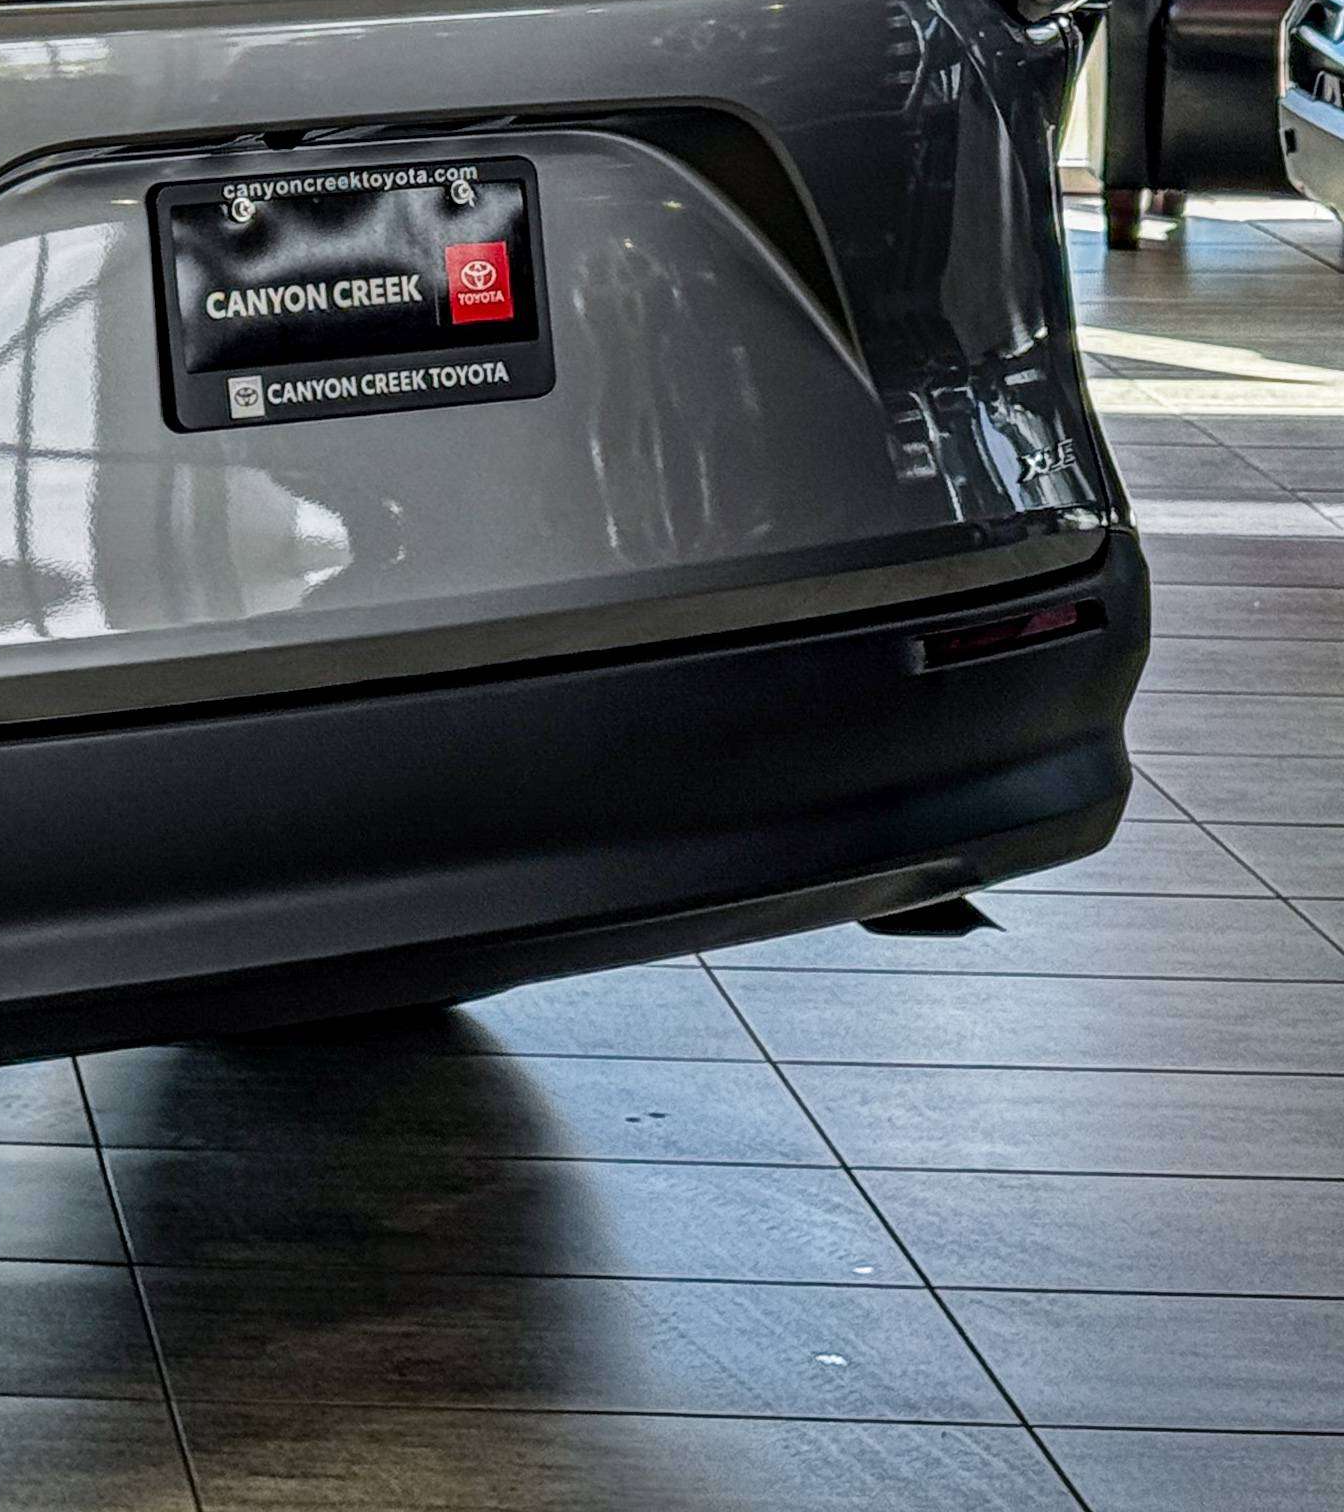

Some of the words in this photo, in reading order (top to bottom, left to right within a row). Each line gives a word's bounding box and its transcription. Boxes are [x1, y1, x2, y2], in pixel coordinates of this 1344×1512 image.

[221, 164, 479, 203] canyoncreektoyota.com
[205, 281, 328, 321] CANYON
[332, 274, 423, 309] CREEK
[457, 289, 505, 307] TOYOTA
[267, 375, 359, 406] CANYON
[360, 369, 428, 397] CREEK
[428, 361, 510, 389] TOYOTA
